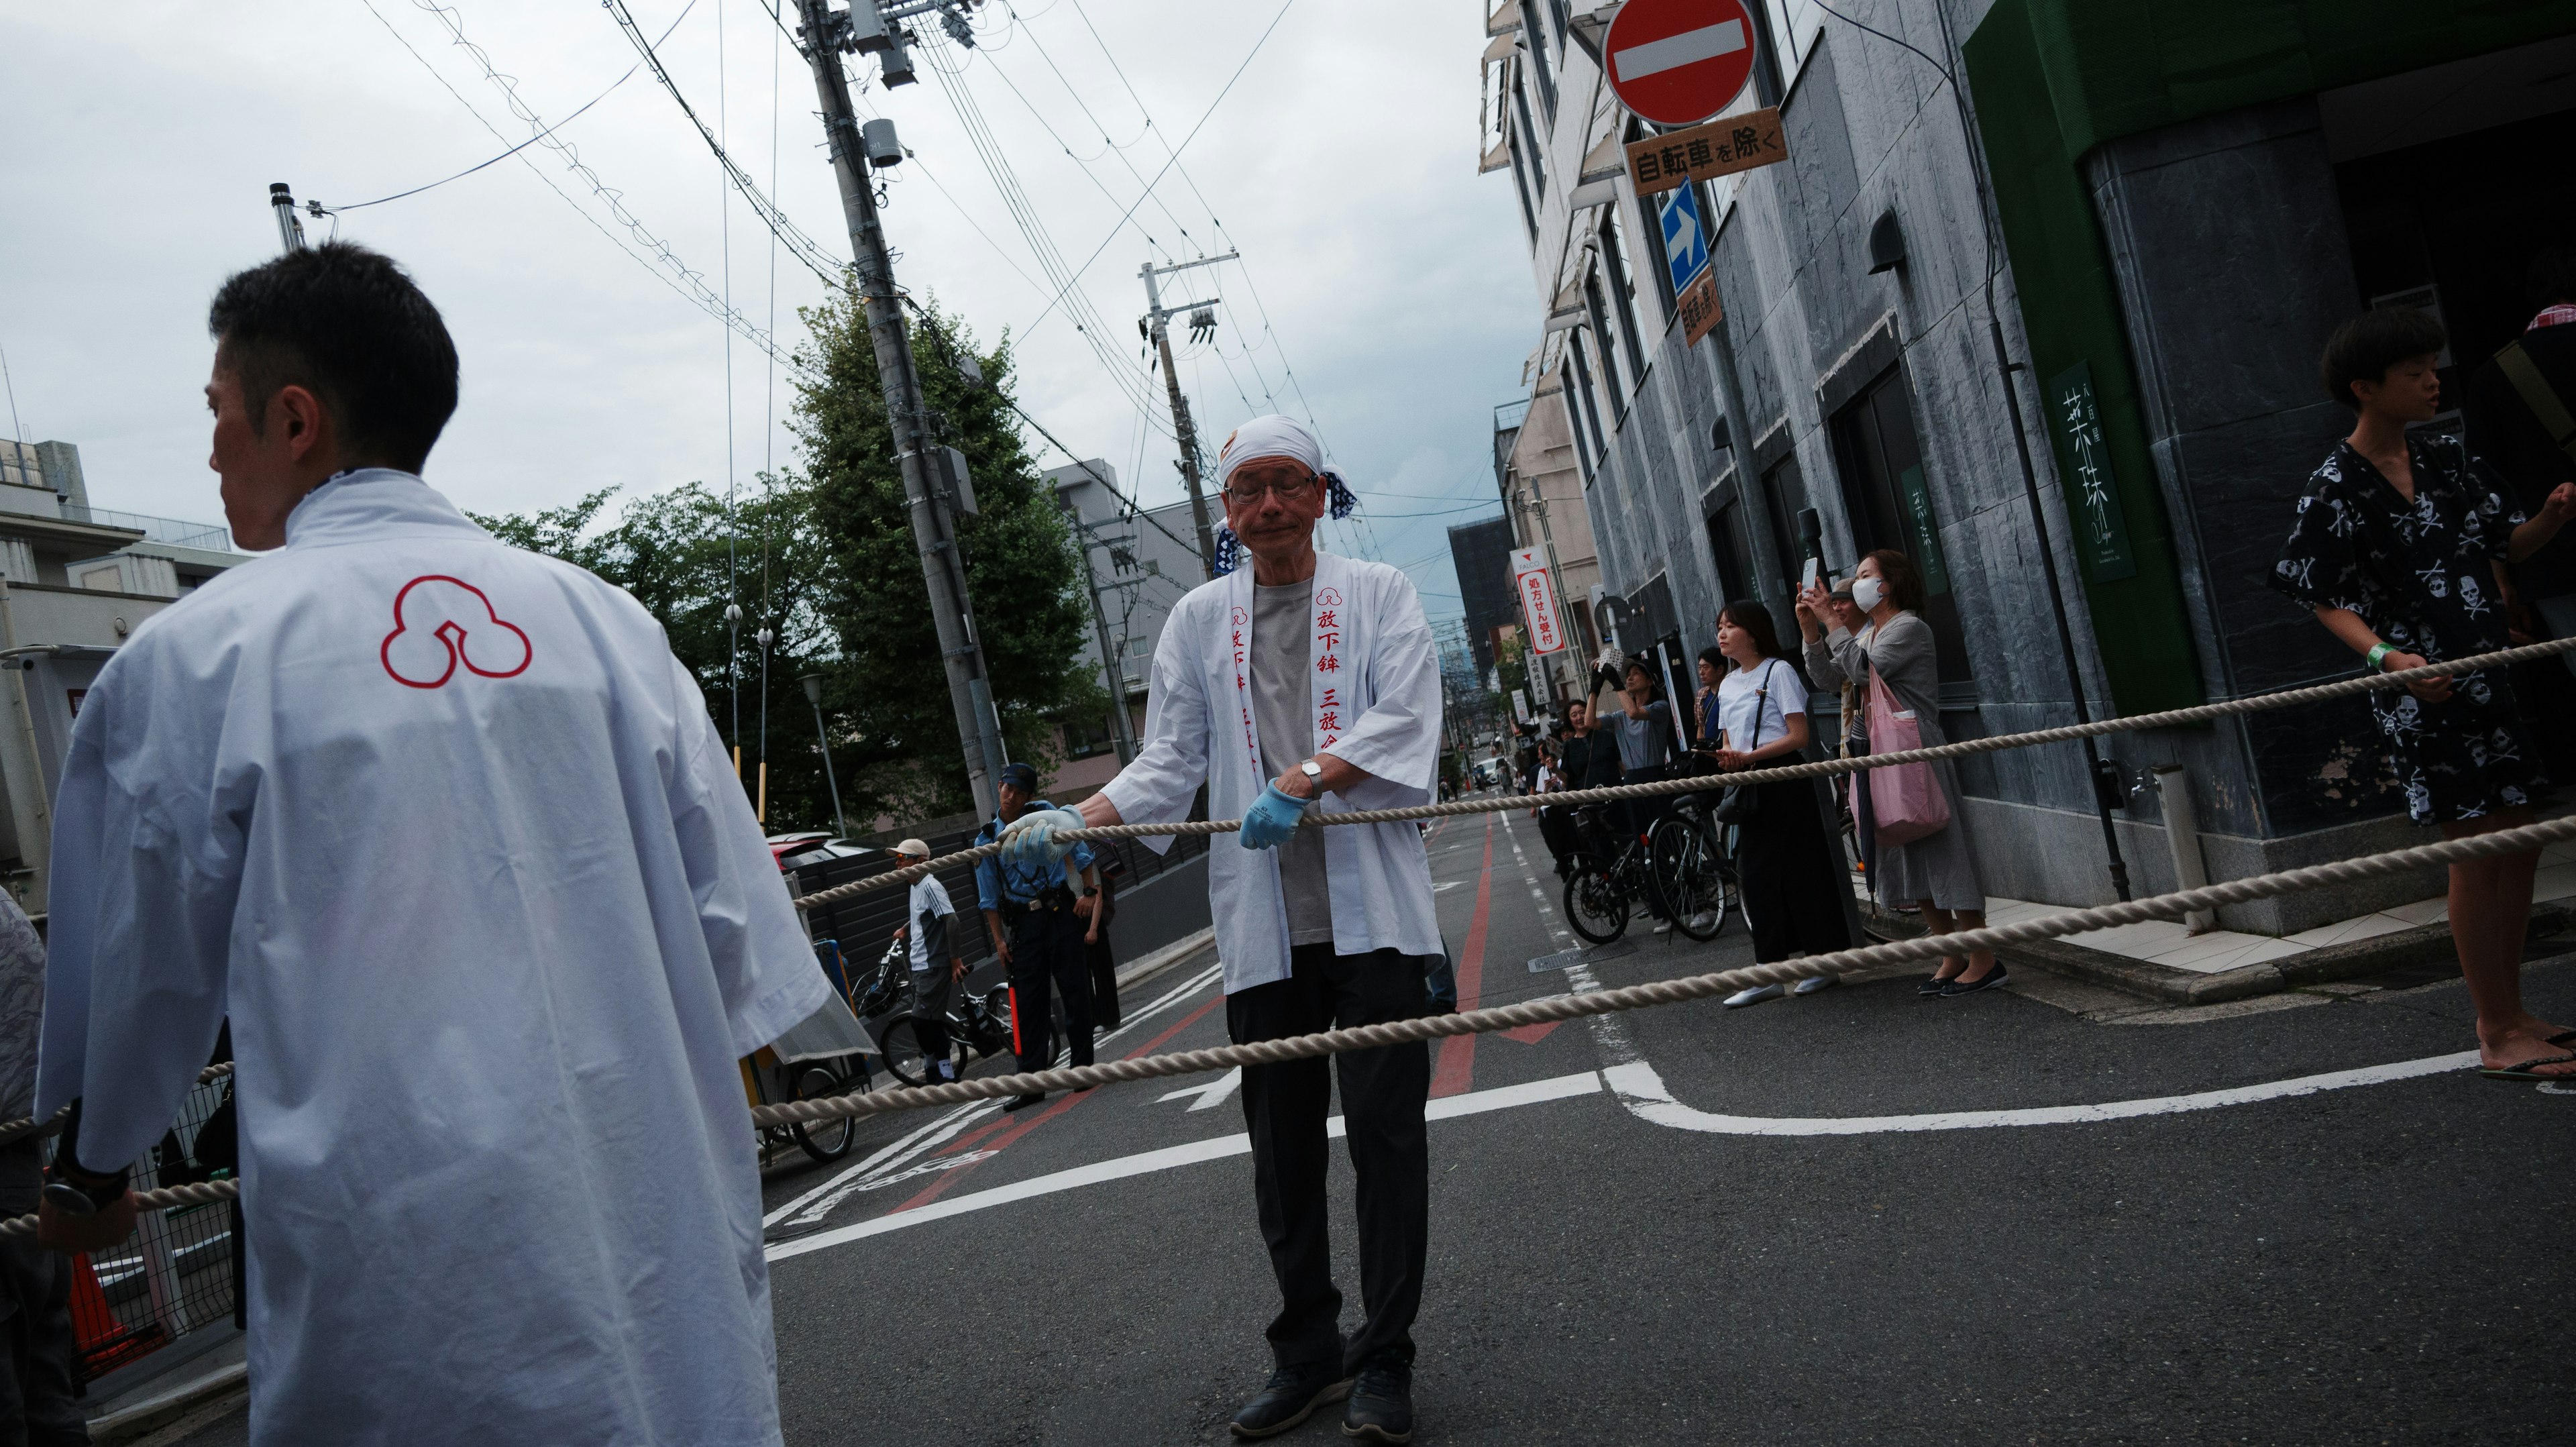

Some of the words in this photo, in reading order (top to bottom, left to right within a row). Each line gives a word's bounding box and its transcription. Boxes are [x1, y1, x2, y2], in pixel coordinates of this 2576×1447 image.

[1637, 125, 1778, 183] 自転車を除く
[1519, 561, 1540, 570] FALCO
[1317, 610, 1340, 674] 放下鉾
[1528, 578, 1554, 647] 処方せん受付
